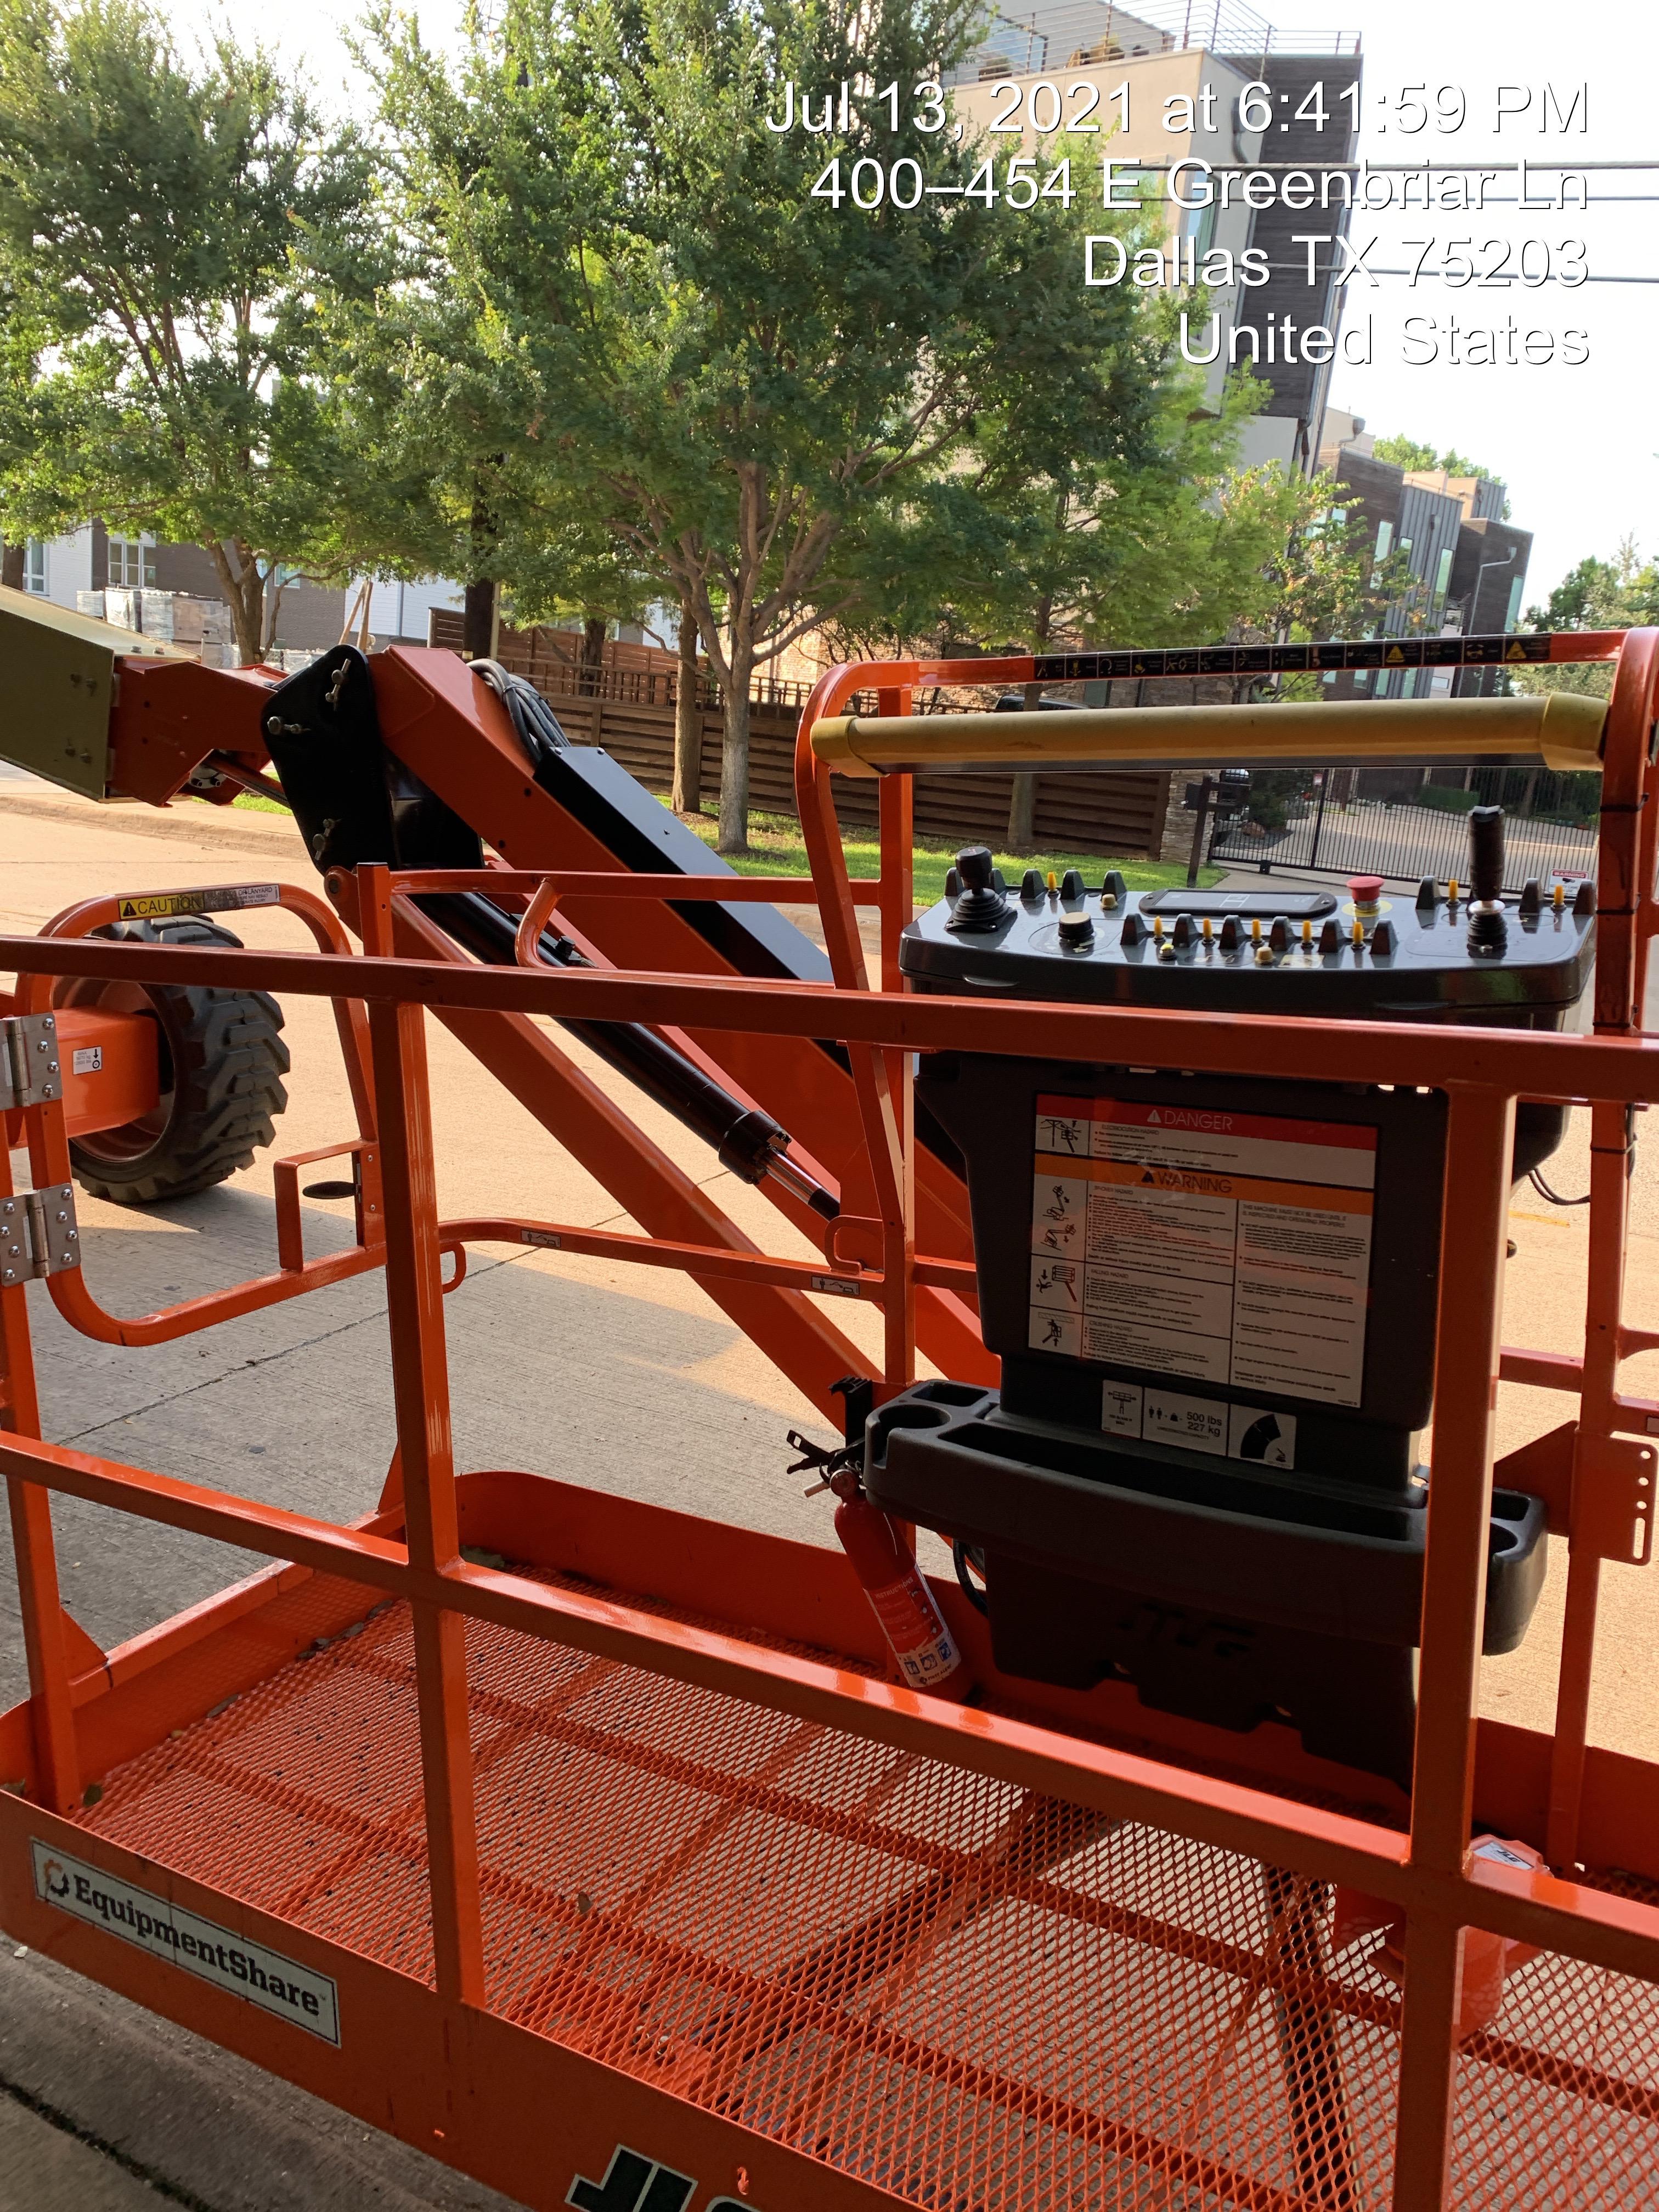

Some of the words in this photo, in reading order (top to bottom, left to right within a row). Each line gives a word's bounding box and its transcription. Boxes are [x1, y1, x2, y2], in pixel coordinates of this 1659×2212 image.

[248, 887, 273, 895] LANYARD
[138, 895, 201, 915] CAUTION
[1164, 1110, 1233, 1131] DANGER
[1158, 1171, 1233, 1193] WARNING
[1186, 1411, 1205, 1423] 500
[1207, 1415, 1222, 1426] lbs
[1187, 1421, 1205, 1432] 227
[1208, 1425, 1221, 1437] kg
[1497, 1850, 1521, 1862] JLG
[74, 1873, 320, 2017] EquipmentShare
